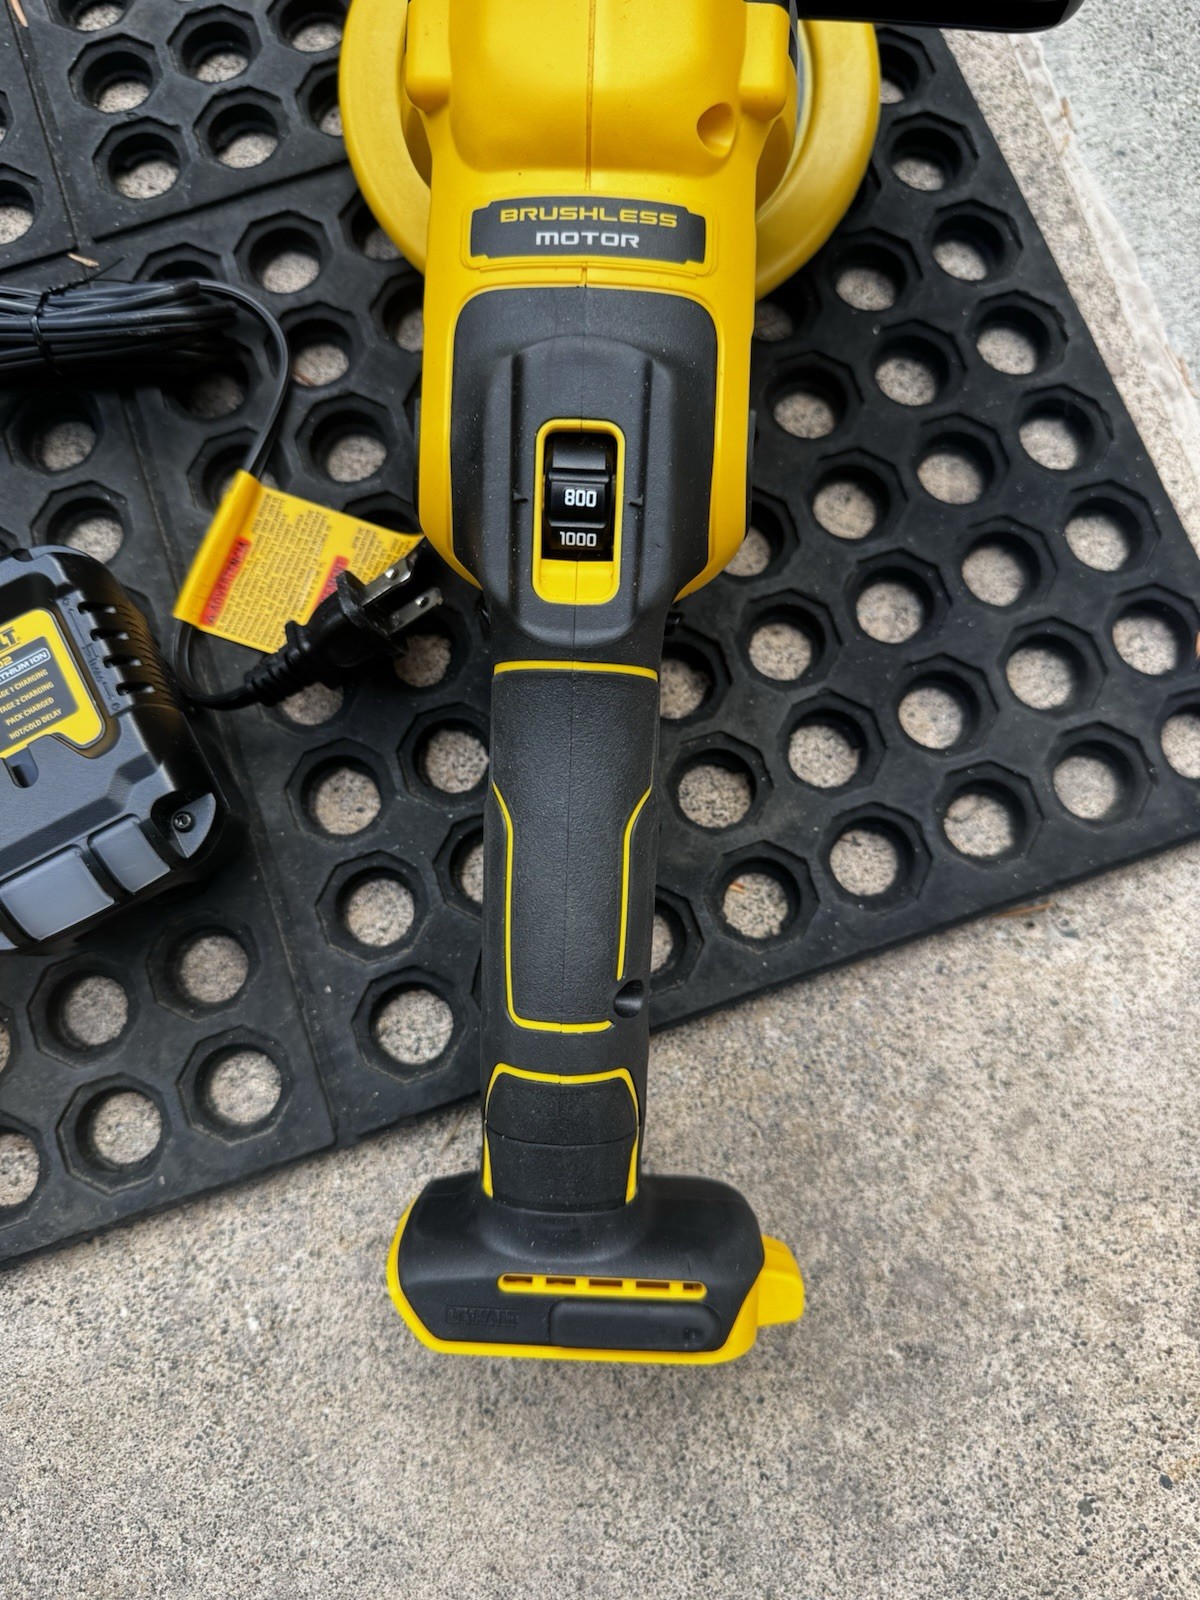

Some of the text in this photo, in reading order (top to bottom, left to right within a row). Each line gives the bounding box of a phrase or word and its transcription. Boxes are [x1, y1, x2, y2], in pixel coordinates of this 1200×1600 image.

[500, 206, 678, 228] BRUSHLESS
[536, 231, 640, 248] MOTOR
[564, 488, 598, 508] 800
[559, 531, 598, 547] 1000
[0, 661, 30, 680] THIUM
[30, 651, 48, 665] ION
[14, 669, 49, 690] CHARGING
[0, 699, 16, 713] TAGE
[20, 681, 55, 702] CHARGING
[6, 697, 55, 726] PACK CHARGED
[9, 708, 62, 740] HOT/COLD DELAY
